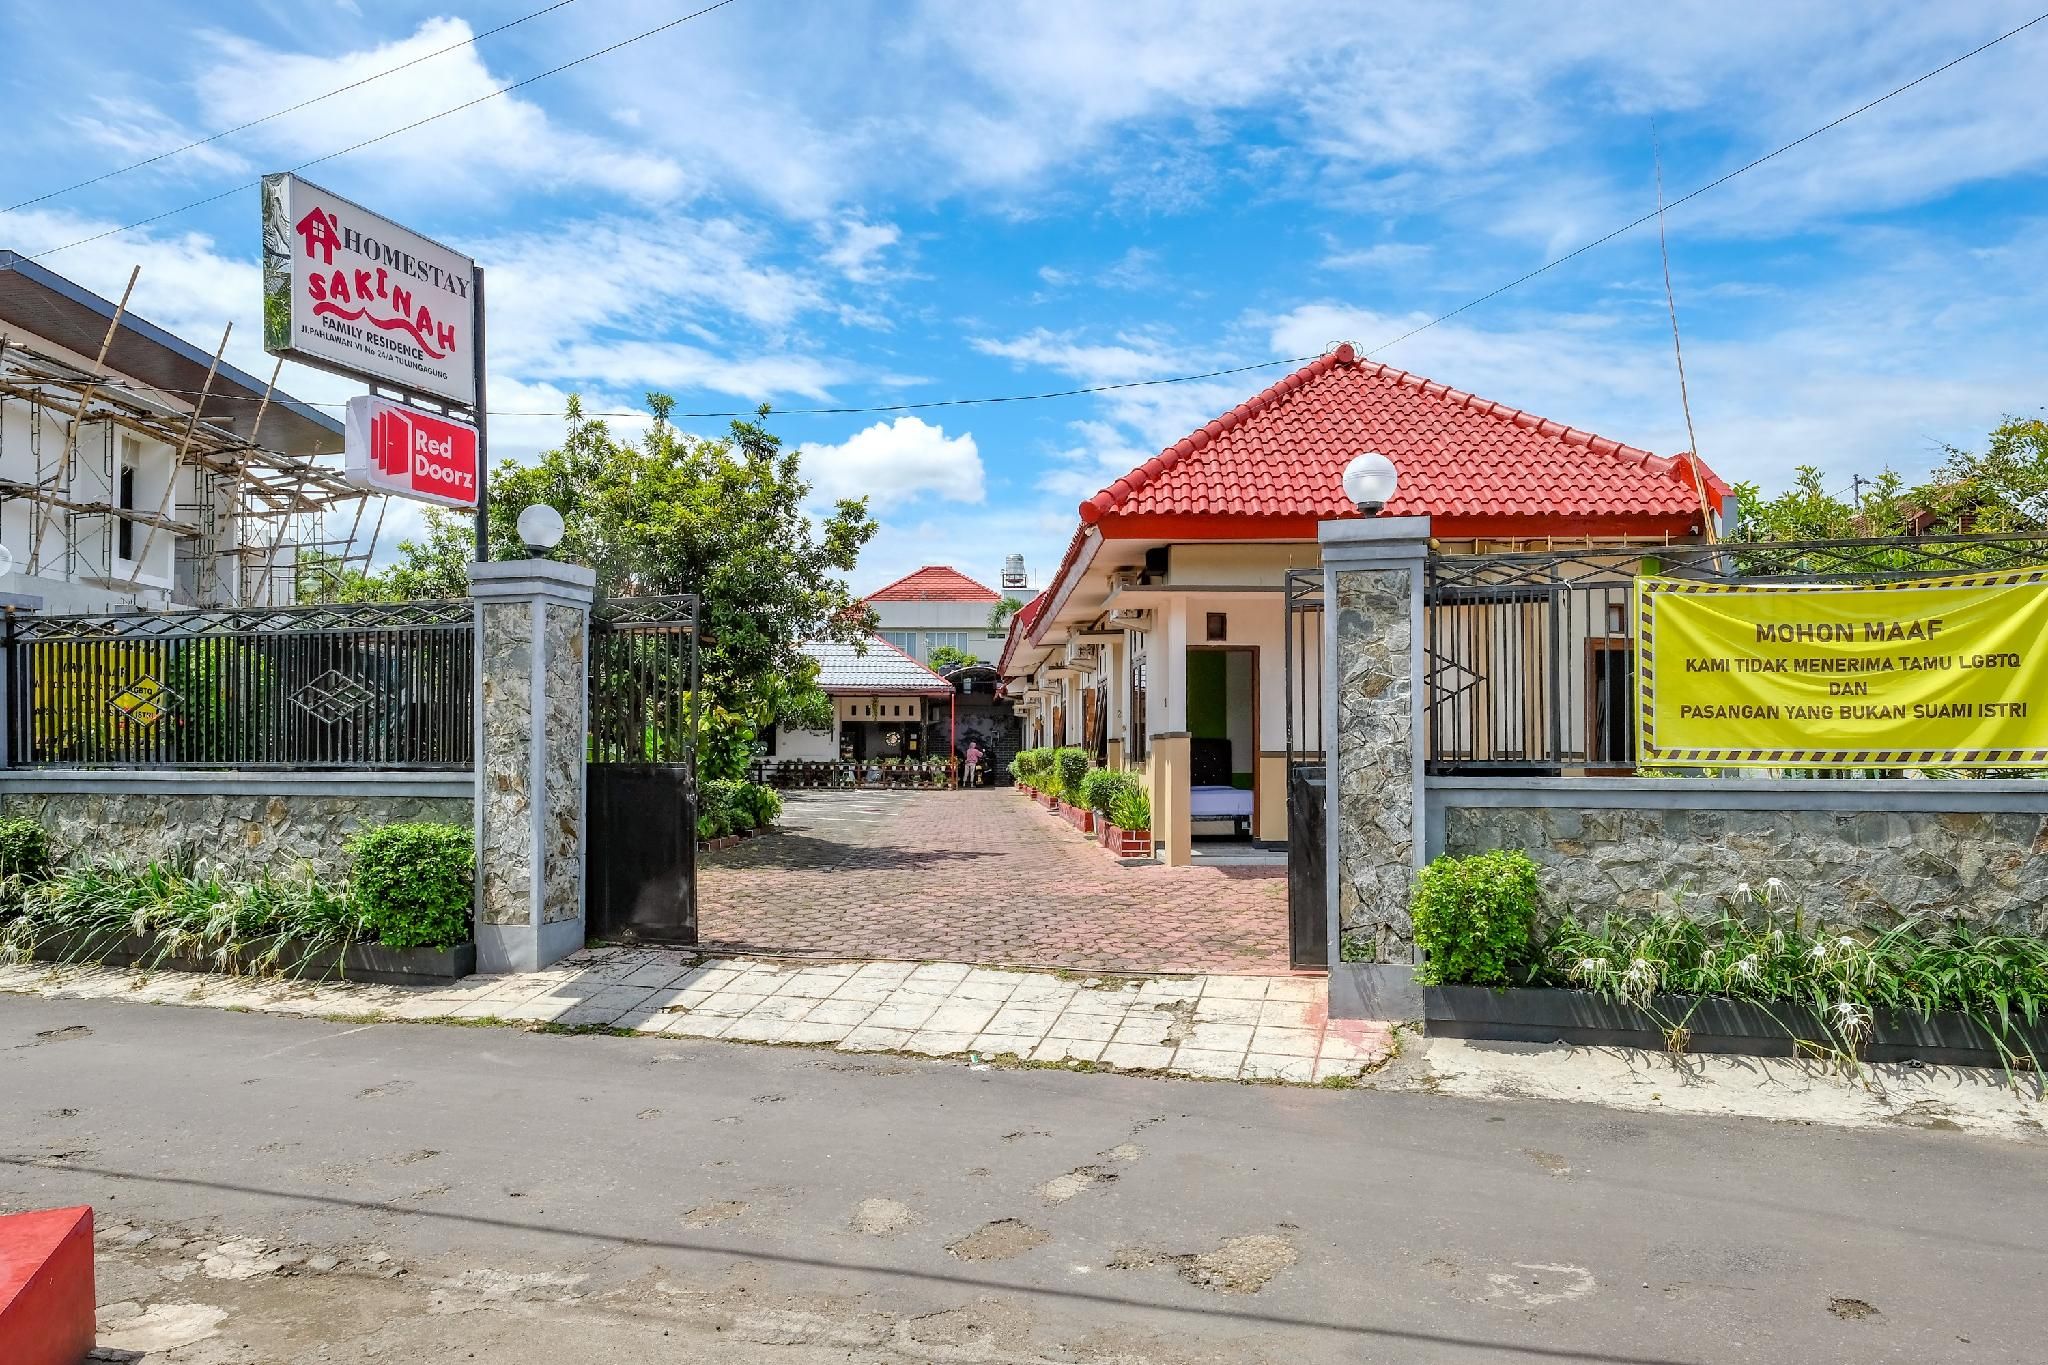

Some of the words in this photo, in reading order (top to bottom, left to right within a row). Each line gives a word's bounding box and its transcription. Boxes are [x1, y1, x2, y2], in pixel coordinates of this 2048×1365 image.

[343, 226, 470, 298] HOMESTAY
[308, 267, 456, 352] SAKINAH
[322, 315, 362, 339] FAMILY
[366, 331, 424, 361] RESIDENCE
[415, 428, 452, 460] Red
[415, 453, 473, 489] Doorz
[1755, 622, 1854, 643] MOHON
[1863, 619, 1943, 641] MAAF
[1685, 657, 1731, 673] KAMI
[1735, 658, 1788, 673] TIDAK
[1793, 656, 1894, 673] MENERIMA
[1898, 655, 1952, 671] TAMU
[1959, 653, 2021, 669] LGBTQ
[1828, 681, 1868, 696] DAN
[1680, 704, 1780, 720] PASANGAN
[1784, 705, 1833, 720] YANG
[1839, 704, 1906, 720] BUKAN
[1913, 703, 1973, 719] SUAMI
[1978, 702, 2028, 718] ISTRI
